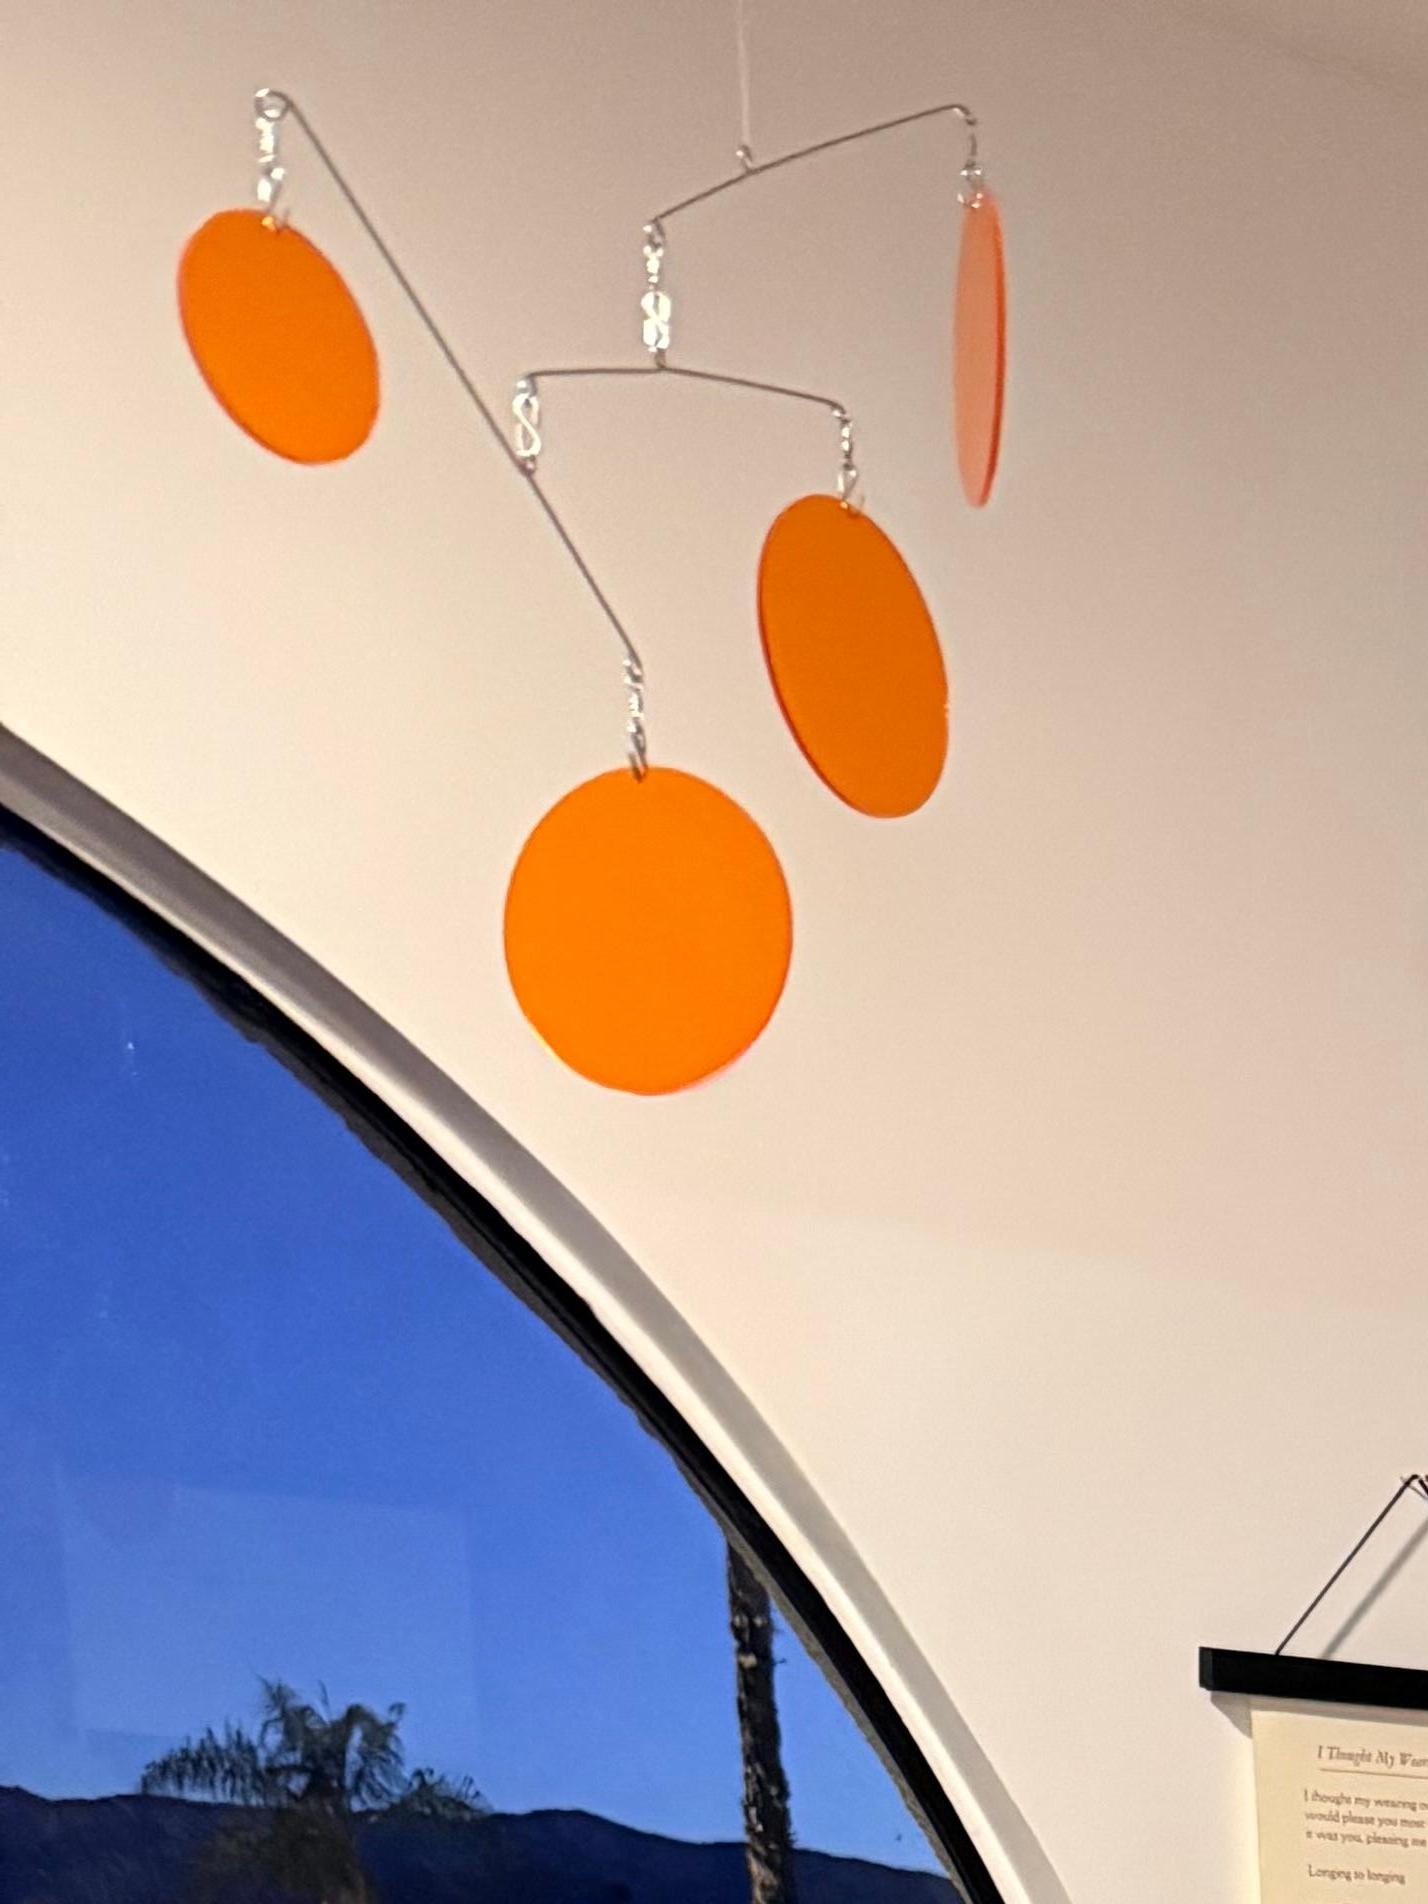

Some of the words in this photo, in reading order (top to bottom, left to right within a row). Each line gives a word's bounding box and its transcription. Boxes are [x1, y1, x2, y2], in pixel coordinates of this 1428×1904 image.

[1375, 1750, 1395, 1768] My
[1308, 1864, 1352, 1881] Longing
[1354, 1871, 1364, 1880] to
[1367, 1868, 1406, 1885] longing
